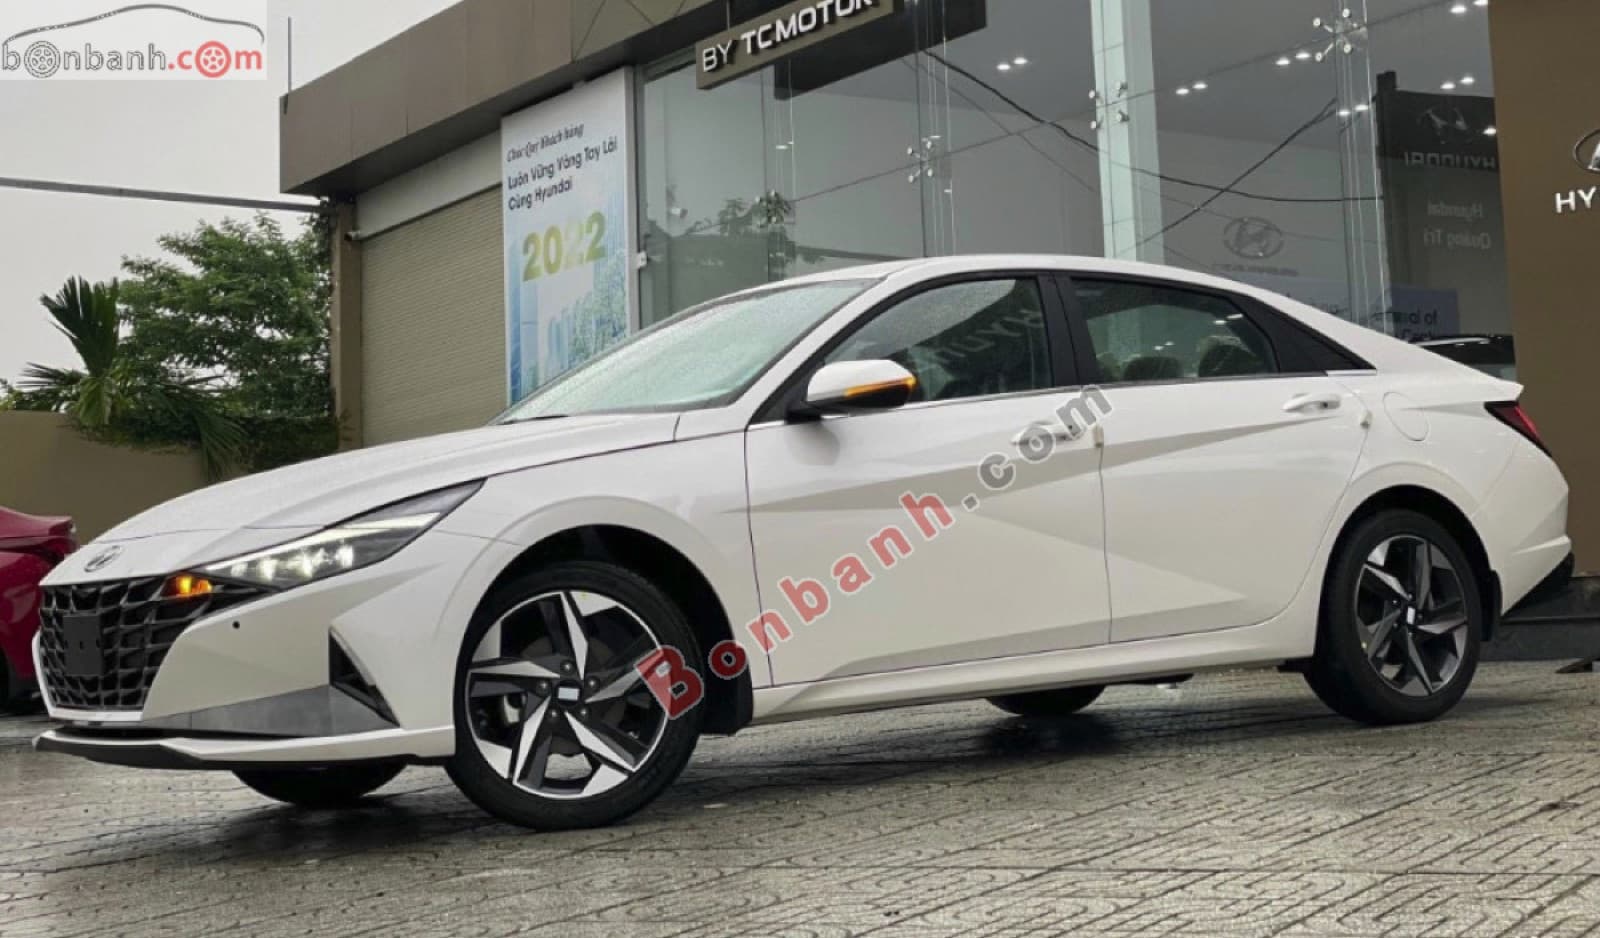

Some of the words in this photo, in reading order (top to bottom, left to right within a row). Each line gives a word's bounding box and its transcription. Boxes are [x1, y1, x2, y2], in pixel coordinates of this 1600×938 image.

[702, 40, 732, 72] BY
[584, 146, 601, 162] Tay
[508, 193, 532, 211] Cùng
[535, 176, 573, 203] Hyundai
[522, 211, 606, 282] 2022
